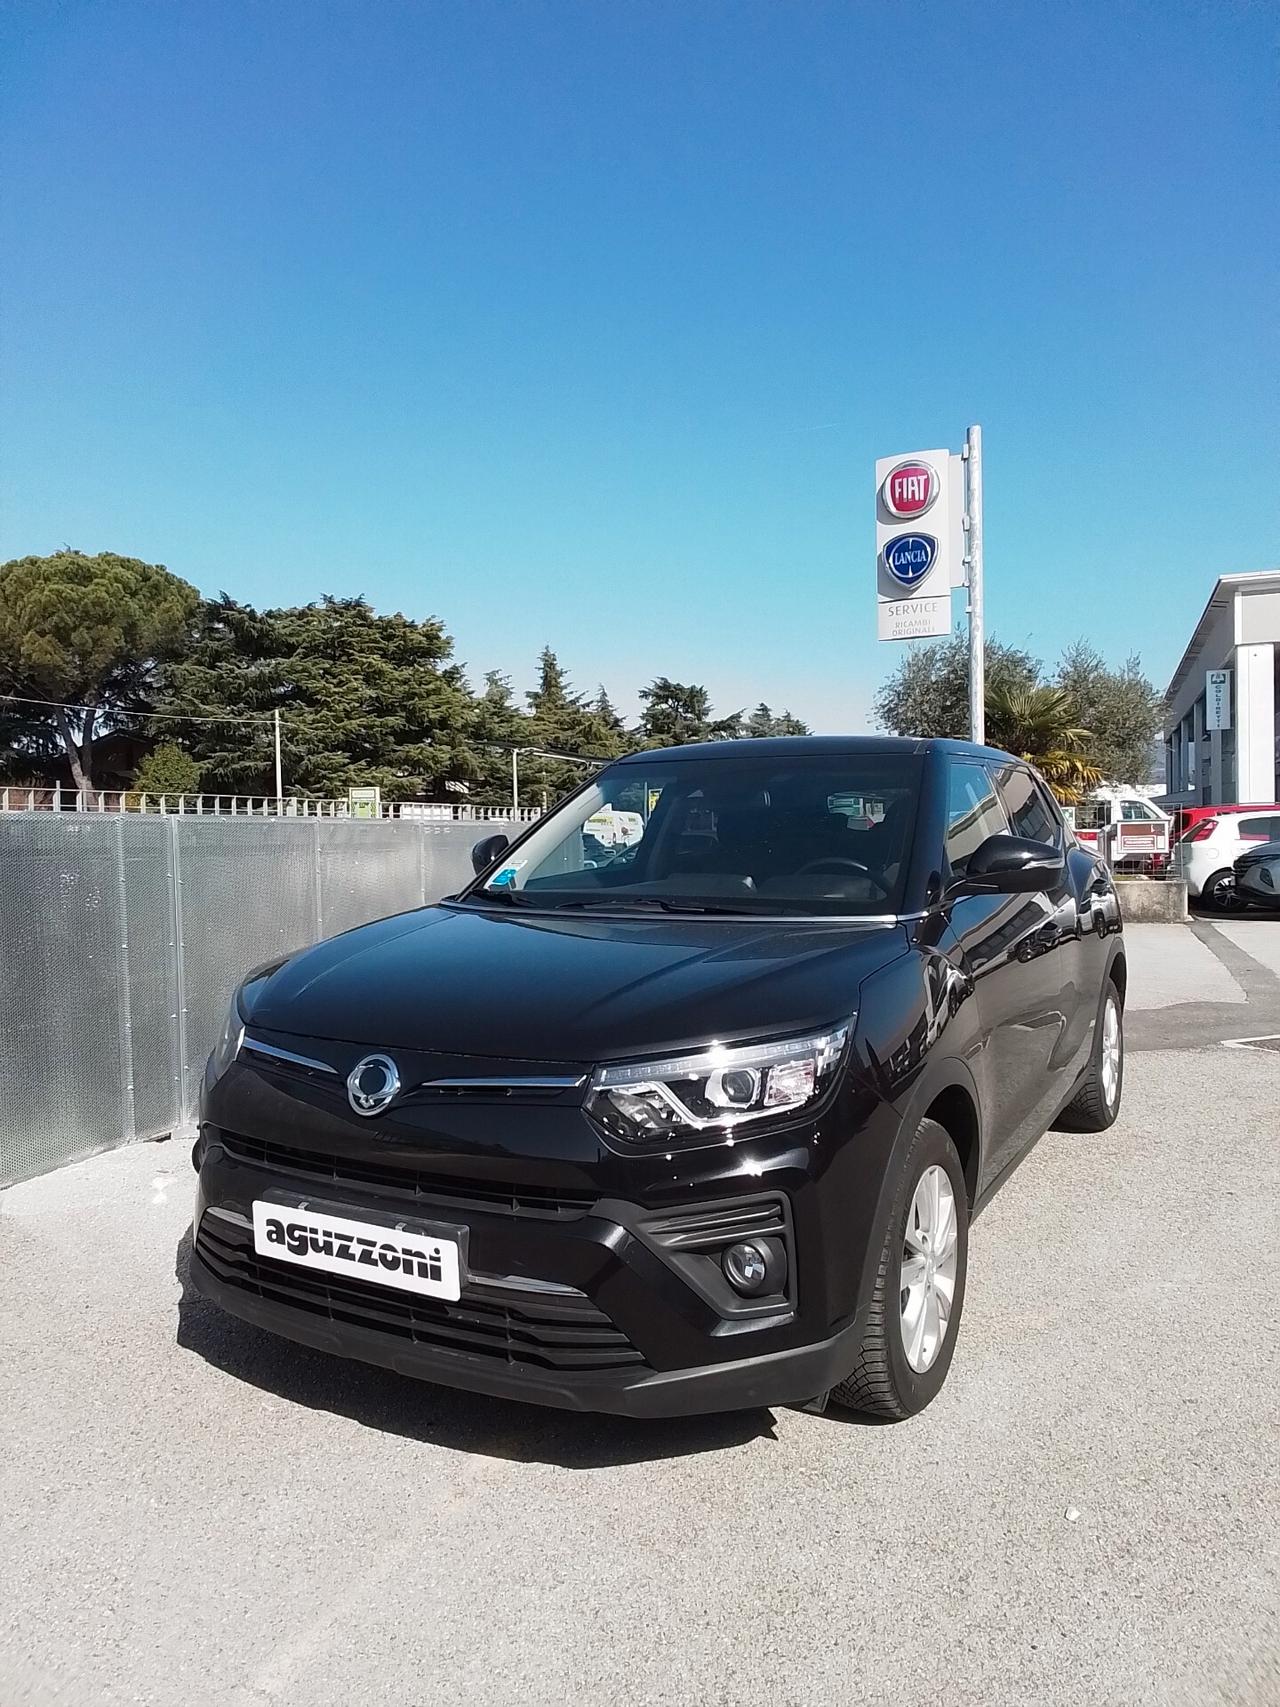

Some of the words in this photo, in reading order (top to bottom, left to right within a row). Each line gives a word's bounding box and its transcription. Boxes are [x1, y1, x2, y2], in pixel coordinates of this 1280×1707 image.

[895, 475, 927, 503] FIAT
[894, 549, 927, 566] LANCIA
[888, 602, 937, 617] SERVICE
[892, 627, 935, 637] ORIGINALI
[895, 619, 931, 629] RICAMBI
[266, 1218, 442, 1282] aguzzoni
